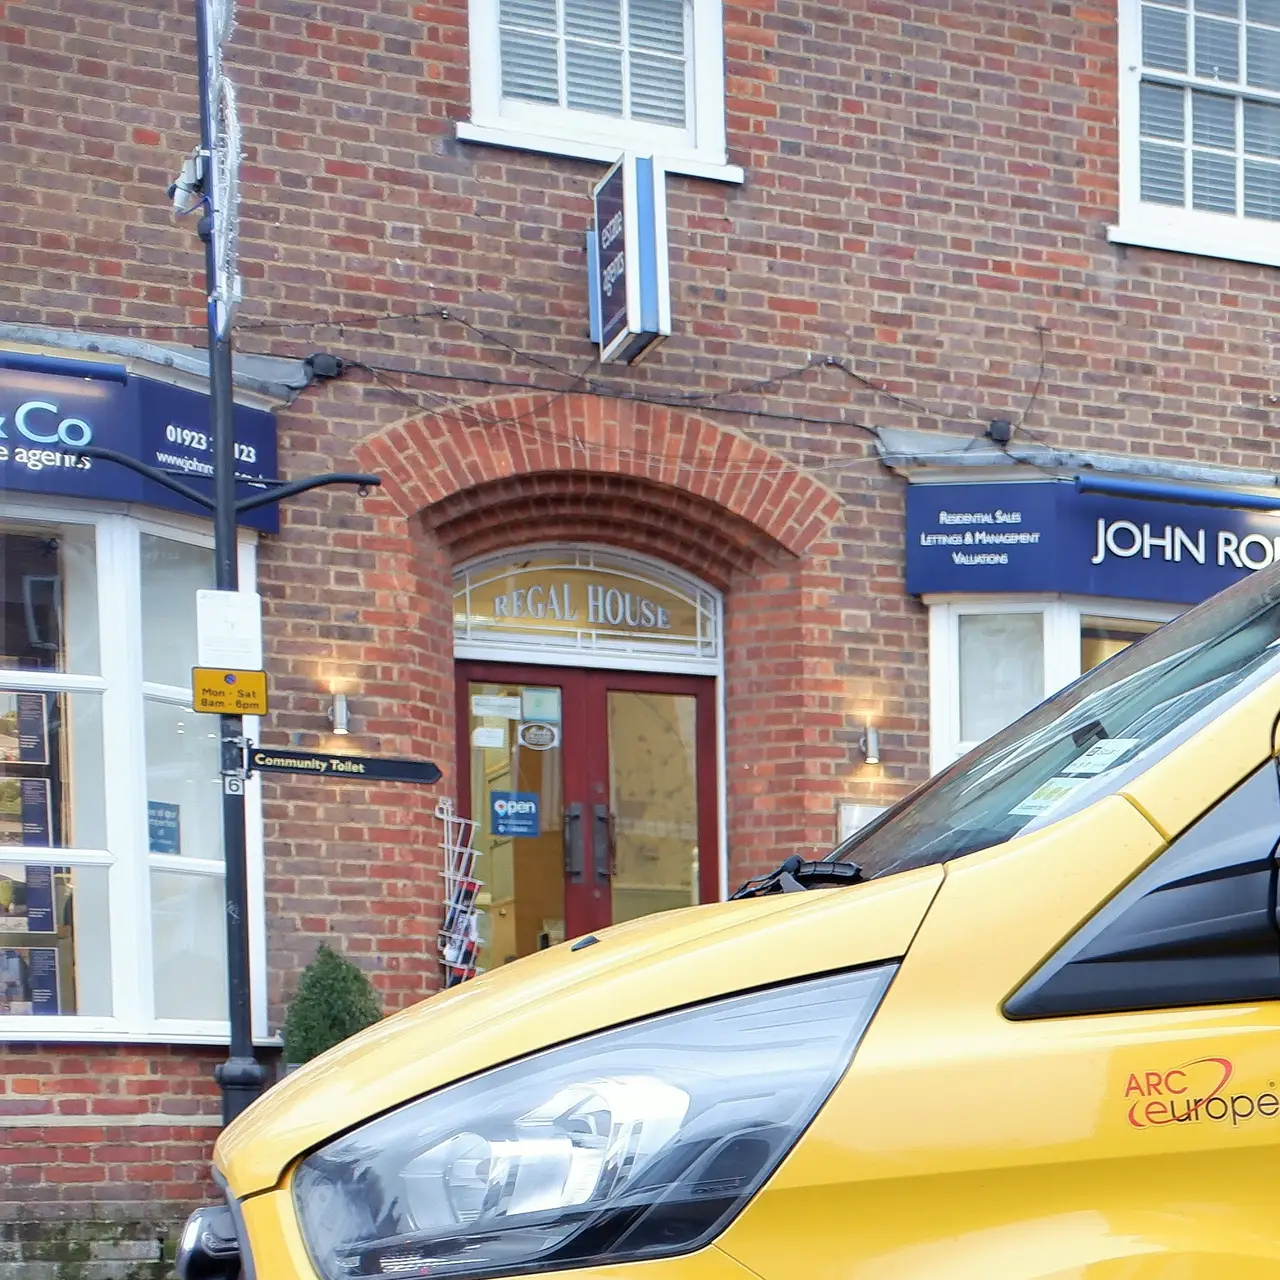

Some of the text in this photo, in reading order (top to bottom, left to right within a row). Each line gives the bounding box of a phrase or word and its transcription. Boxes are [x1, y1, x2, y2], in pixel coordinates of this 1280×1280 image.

[15, 401, 92, 446] Co
[165, 424, 208, 450] 01923
[1091, 518, 1205, 564] JOHN
[493, 583, 671, 629] REGAL HOUSE
[202, 688, 226, 698] Mon
[236, 688, 257, 699] Sat
[255, 753, 365, 773] Community Toilet
[228, 779, 241, 793] 6
[1124, 1069, 1189, 1098] ARC
[1144, 1092, 1280, 1126] europe
